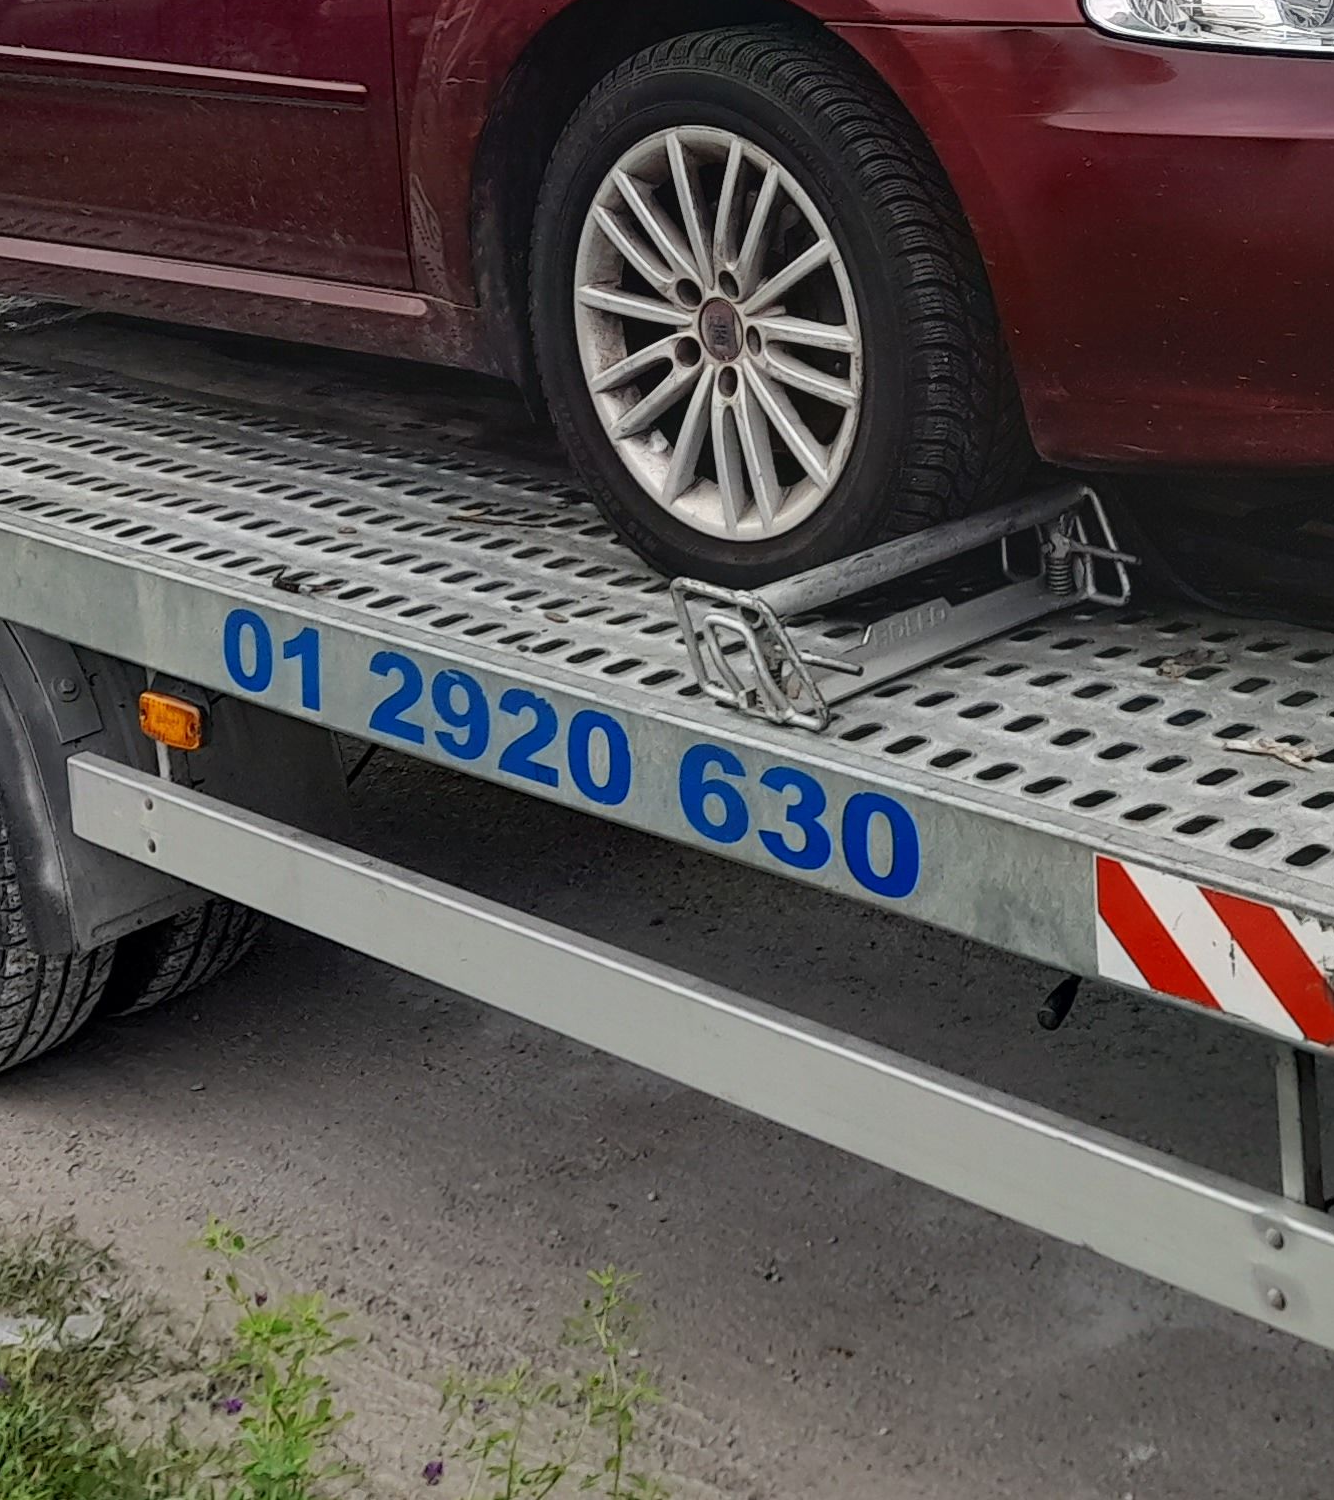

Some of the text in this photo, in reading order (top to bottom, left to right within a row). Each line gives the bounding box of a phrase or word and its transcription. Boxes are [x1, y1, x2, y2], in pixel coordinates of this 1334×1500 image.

[223, 608, 920, 899] 01 2920 630
